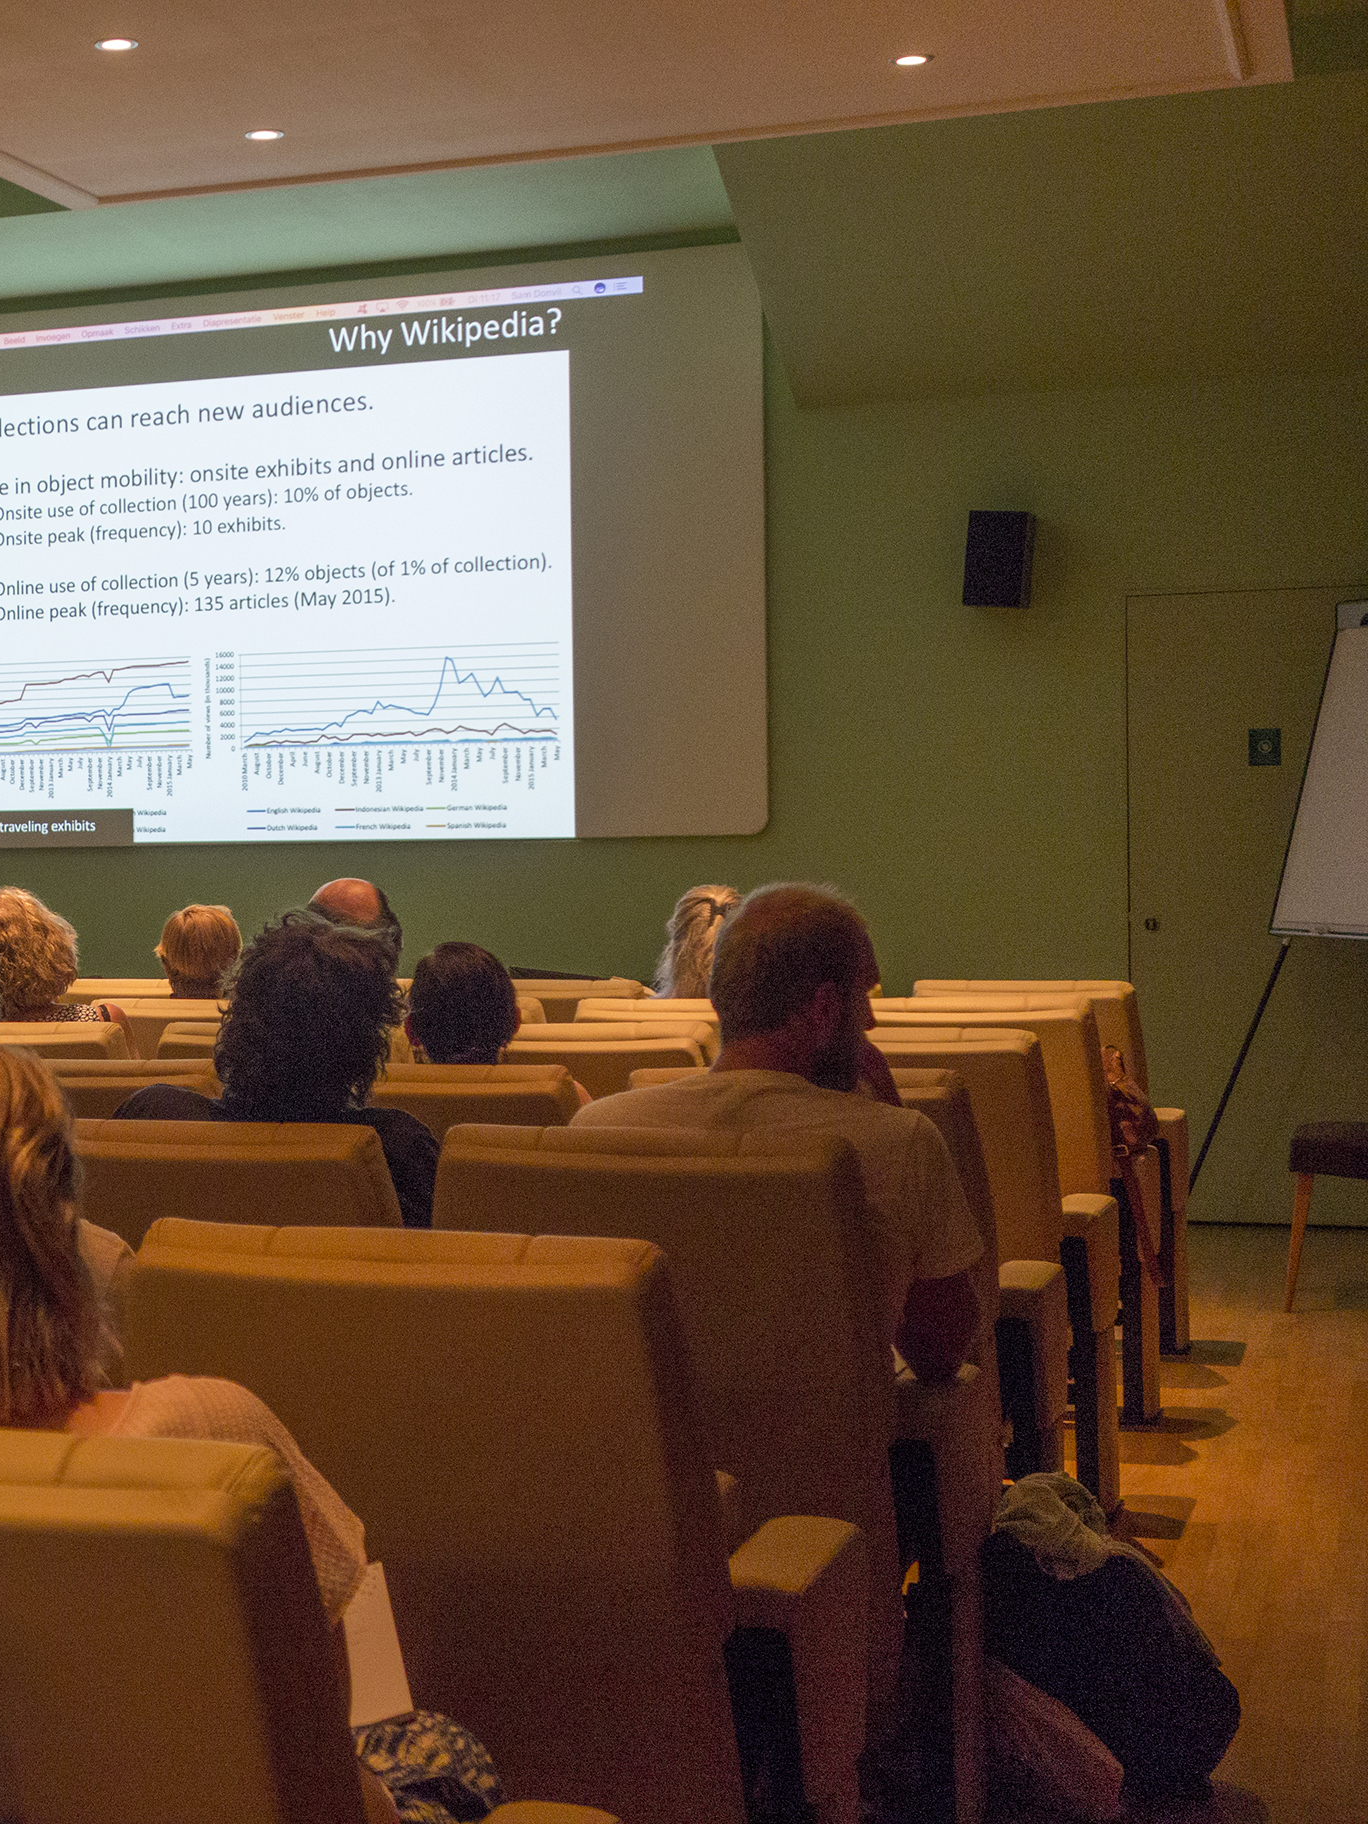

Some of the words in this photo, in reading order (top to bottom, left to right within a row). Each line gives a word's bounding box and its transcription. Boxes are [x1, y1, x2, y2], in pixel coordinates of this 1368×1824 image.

[4, 336, 26, 345] Beeld
[36, 332, 70, 344] Invoegen
[81, 328, 114, 340] Opmaak
[124, 324, 160, 334] Schikken
[171, 320, 192, 330] Extra
[203, 312, 262, 328] Diapresentatie
[273, 310, 304, 320] Venster
[316, 307, 336, 318] Help
[330, 324, 393, 354] Why
[401, 308, 562, 347] Wikipedia?
[87, 413, 123, 431] can
[131, 404, 189, 427] reach
[198, 405, 244, 422] new
[253, 395, 373, 418] audiences.
[15, 478, 31, 494] in
[37, 474, 94, 496] object
[101, 468, 184, 490] mobility:
[190, 463, 249, 483] onsite
[256, 457, 331, 480] exhibits
[338, 454, 374, 473] and
[382, 450, 445, 470] online
[452, 444, 533, 466] articles.
[47, 505, 74, 518] use
[79, 500, 95, 516] of
[100, 496, 176, 515] collection
[183, 493, 218, 512] (100
[223, 489, 278, 510] years):
[284, 487, 318, 504] 10%
[324, 485, 341, 500] of
[346, 482, 413, 502] objects.
[48, 527, 84, 547] peak
[90, 521, 187, 544] (frequency):
[193, 520, 212, 535] 10
[218, 516, 286, 534] exhibits.
[49, 580, 75, 594] use
[81, 576, 96, 592] of
[101, 572, 178, 590] collection
[184, 571, 199, 590] (5
[204, 566, 258, 588] years):
[265, 566, 299, 583] 12%
[304, 563, 365, 584] objects
[371, 560, 395, 580] (of
[400, 559, 425, 576] 1%
[431, 557, 449, 574] of
[454, 553, 552, 573] collection).
[50, 602, 87, 622] peak
[92, 597, 188, 619] (frequency):
[195, 596, 224, 612] 135
[230, 592, 288, 610] articles
[294, 591, 336, 610] (May
[342, 586, 395, 606] 2015).
[0, 821, 48, 834] traveling
[51, 820, 96, 832] exhibits
[447, 822, 473, 830] Spanish
[475, 821, 506, 829] Wikipedia
